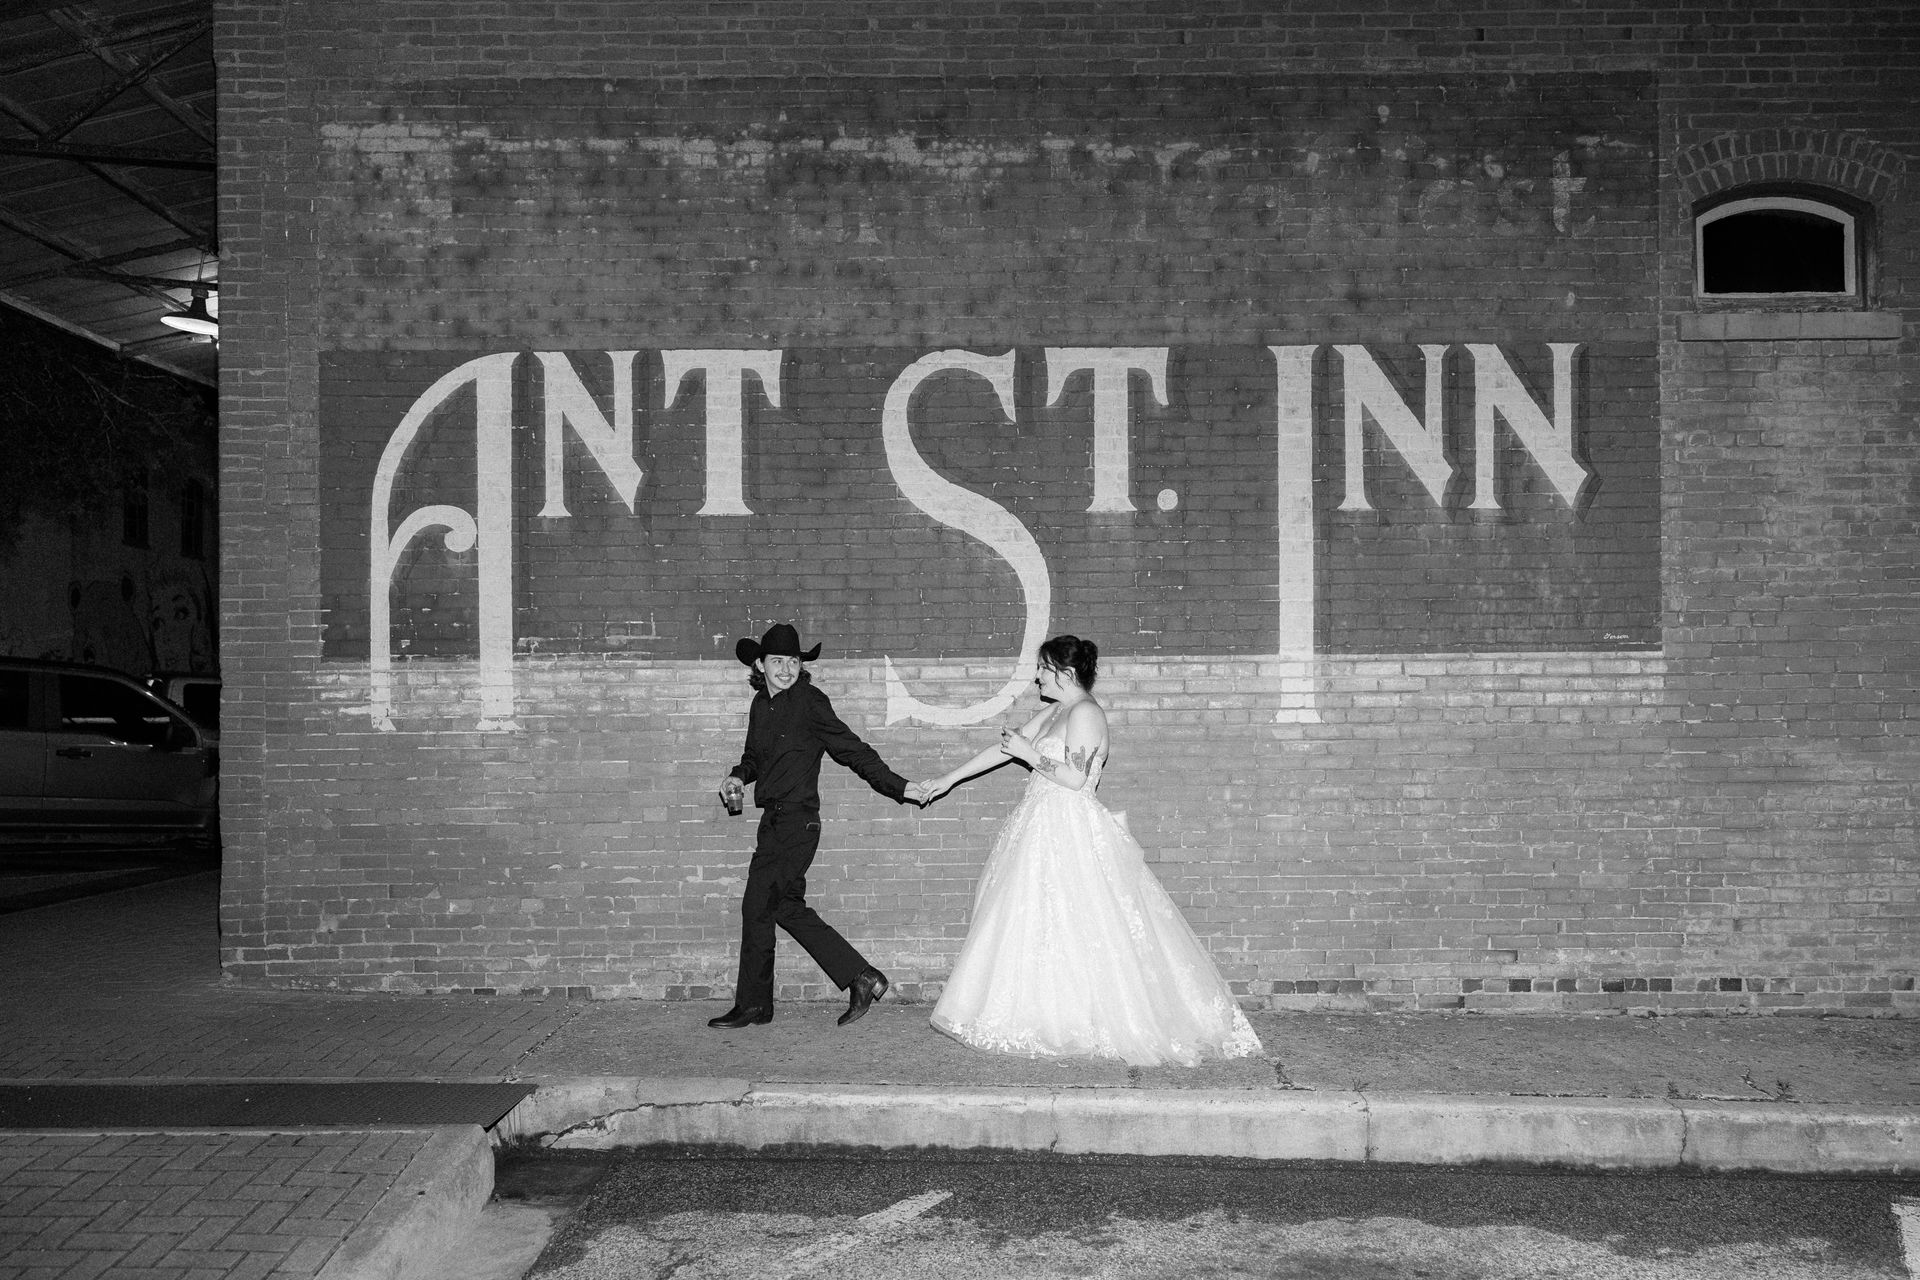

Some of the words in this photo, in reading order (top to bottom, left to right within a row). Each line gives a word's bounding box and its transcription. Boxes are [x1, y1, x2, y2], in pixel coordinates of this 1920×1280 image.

[370, 349, 784, 731] ANT
[881, 347, 1179, 727] ST.
[1267, 343, 1589, 724] INN
